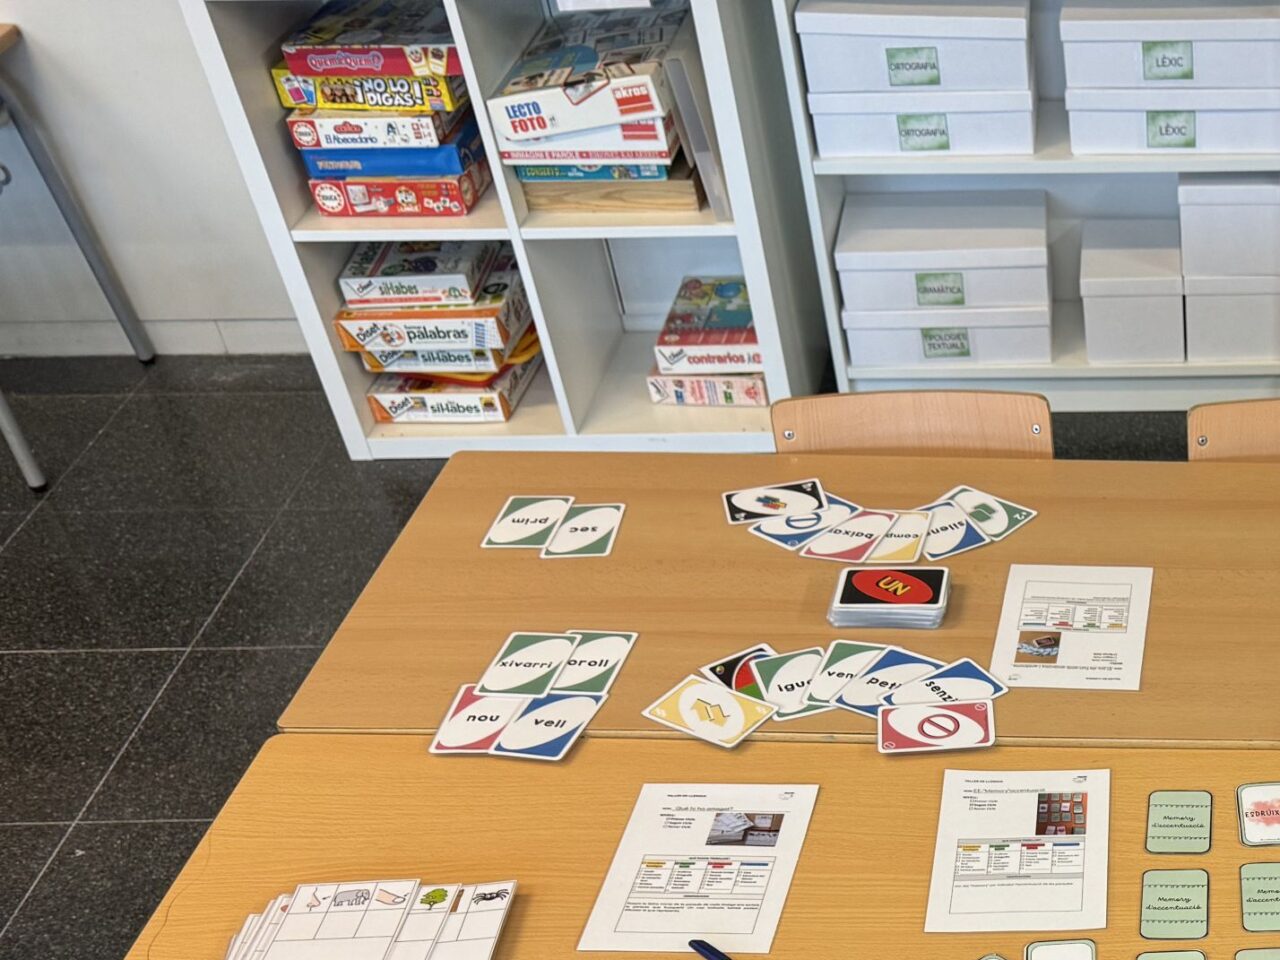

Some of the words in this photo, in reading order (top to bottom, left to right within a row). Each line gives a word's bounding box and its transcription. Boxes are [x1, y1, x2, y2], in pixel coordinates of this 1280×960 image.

[889, 62, 937, 71] ORTOGRAFIA
[389, 78, 410, 93] LO
[505, 101, 542, 120] LECTO
[510, 116, 549, 135] FOTO
[407, 325, 469, 343] palabras
[512, 516, 550, 524] prim
[499, 660, 553, 669] xivarri
[566, 658, 610, 668] oroll
[827, 671, 858, 679] ven
[466, 714, 500, 723] nou
[534, 718, 567, 729] vell
[1162, 814, 1195, 823] Memory
[1157, 896, 1191, 904] Memory
